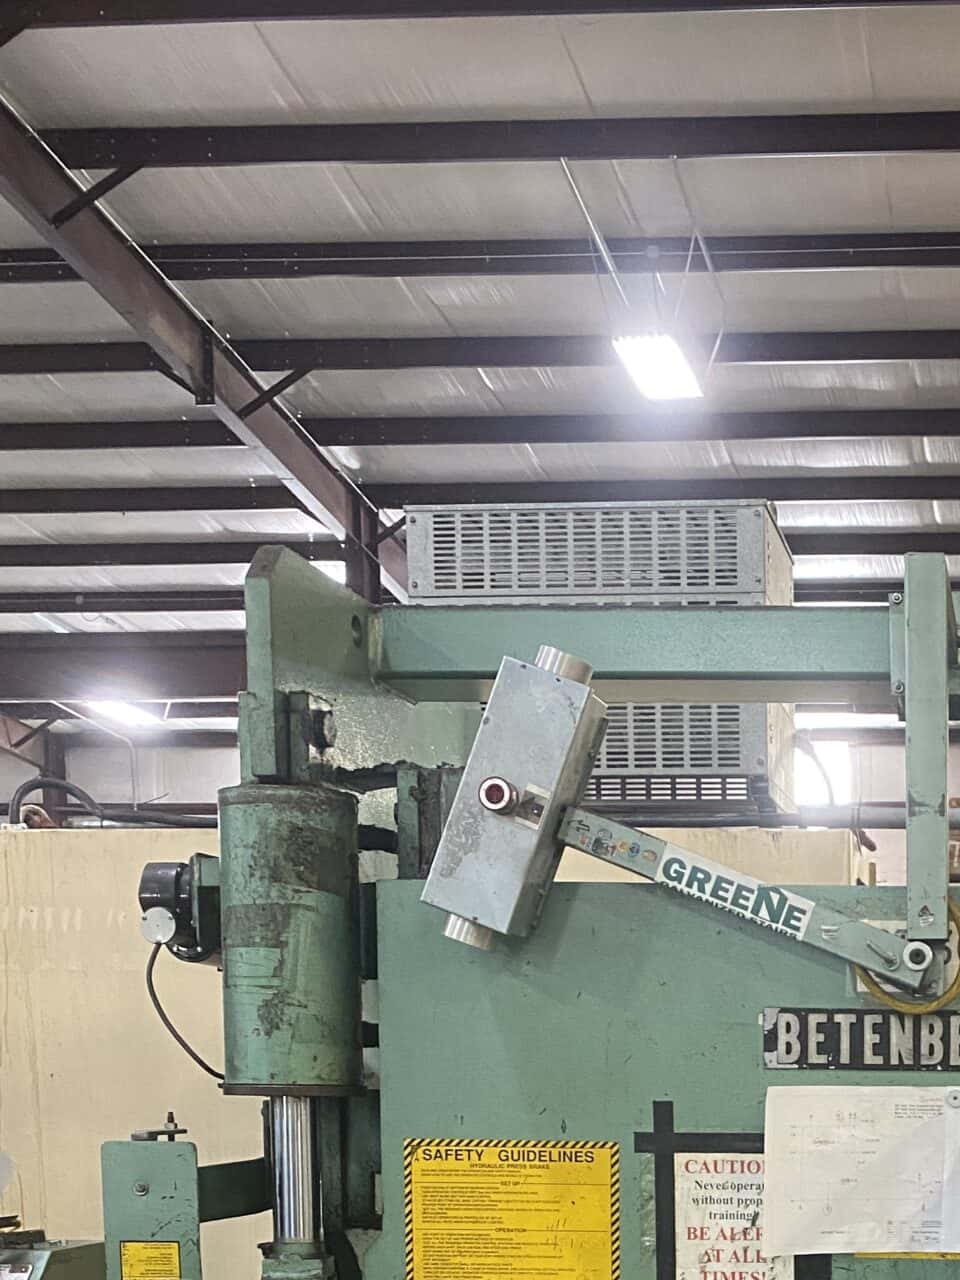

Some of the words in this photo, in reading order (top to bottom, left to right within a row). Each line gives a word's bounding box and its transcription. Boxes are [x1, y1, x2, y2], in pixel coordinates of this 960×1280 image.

[662, 857, 808, 932] GREENE
[422, 1148, 484, 1161] SAFETY
[498, 1149, 595, 1163] GUIDELINES
[684, 1159, 764, 1174] CAUTIO
[692, 1195, 733, 1205] without
[687, 1226, 710, 1241] BE
[700, 1248, 724, 1263] AT
